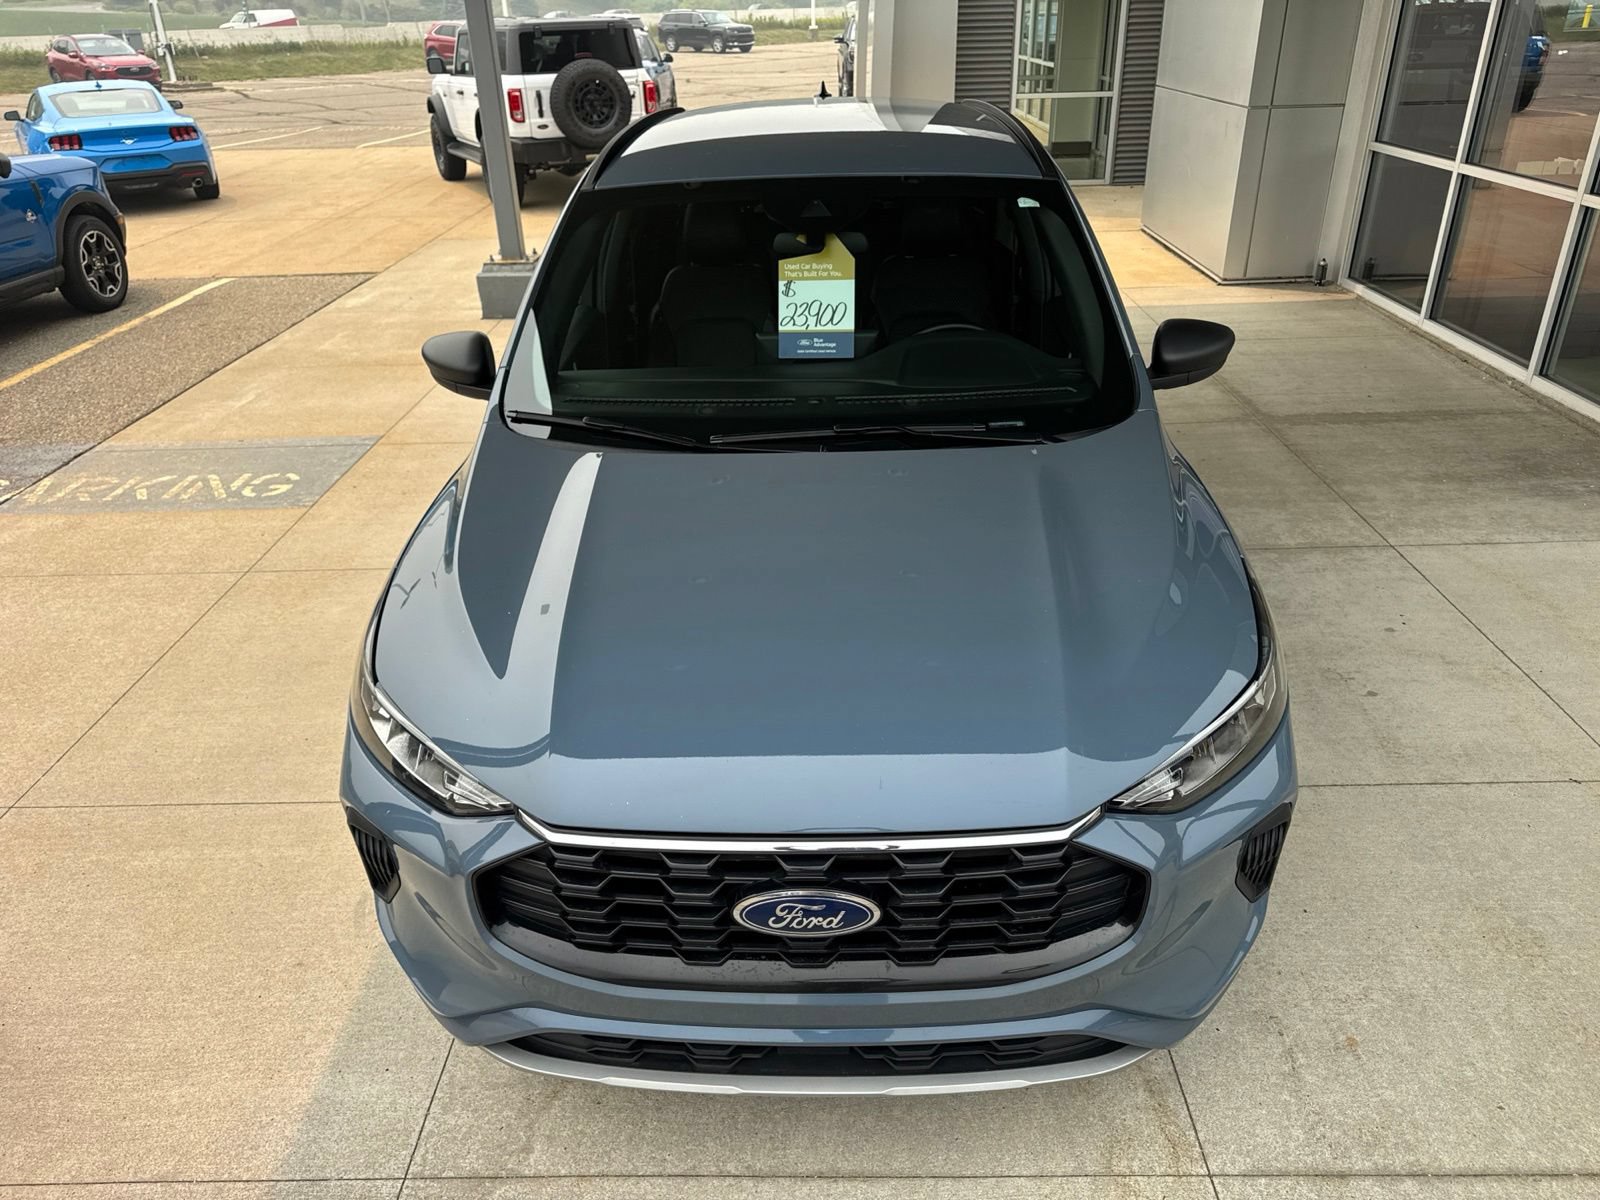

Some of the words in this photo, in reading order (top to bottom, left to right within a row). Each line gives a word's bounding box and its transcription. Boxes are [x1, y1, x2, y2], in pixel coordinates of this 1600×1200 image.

[784, 270, 803, 278] That's
[812, 263, 833, 271] Buying
[781, 280, 796, 297] $
[0, 472, 300, 504] ARKING
[768, 902, 846, 929] Ford
